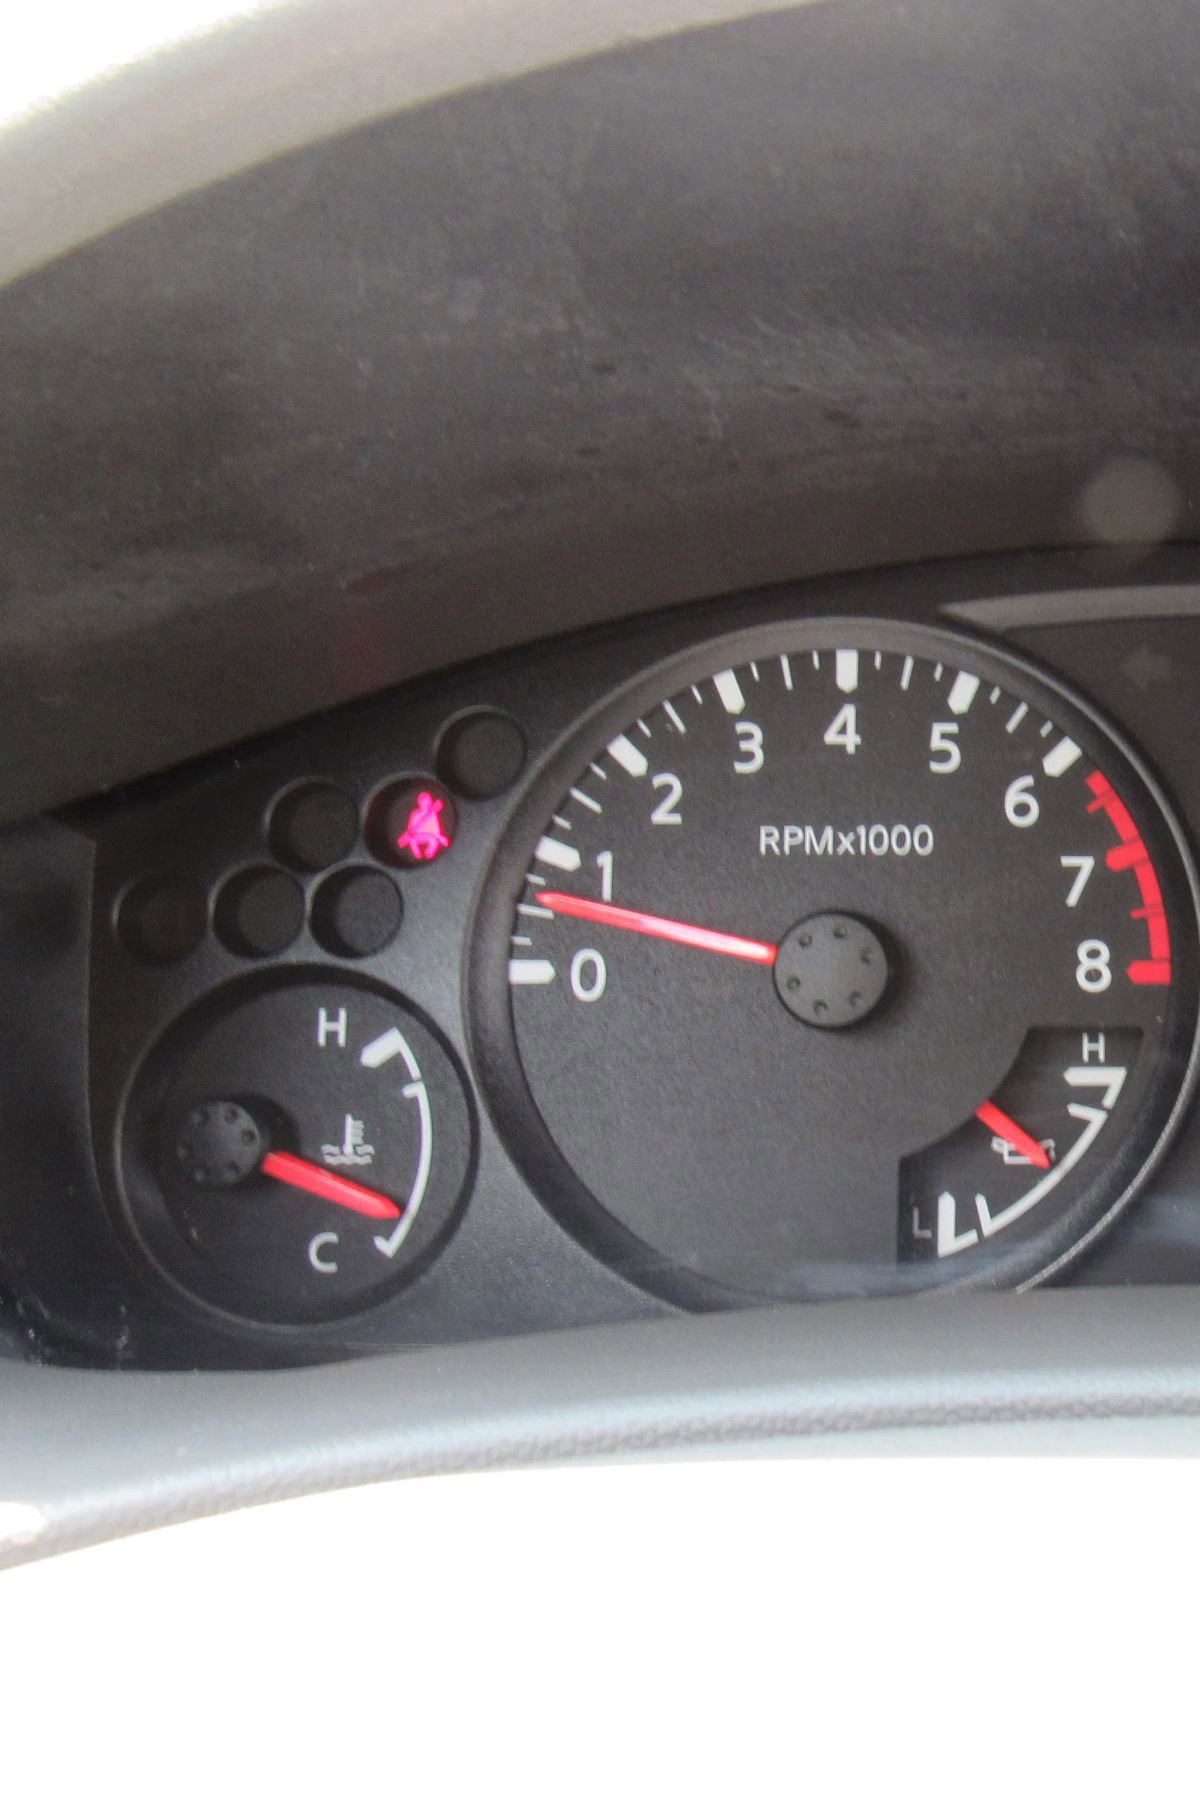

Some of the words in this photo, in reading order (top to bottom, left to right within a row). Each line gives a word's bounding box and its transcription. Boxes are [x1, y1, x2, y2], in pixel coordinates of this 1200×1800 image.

[733, 721, 765, 774] 3
[823, 703, 862, 755] 4
[929, 722, 962, 774] 5
[650, 772, 683, 825] 2
[1004, 774, 1040, 828] 6
[759, 823, 934, 856] RPMx1000
[596, 850, 613, 901] 1
[1060, 855, 1095, 907] 7
[570, 948, 607, 1002] 0
[1075, 939, 1112, 993] 8
[317, 1007, 347, 1047] H
[1081, 1033, 1106, 1063] H
[912, 1207, 934, 1239] L
[308, 1231, 339, 1273] C
